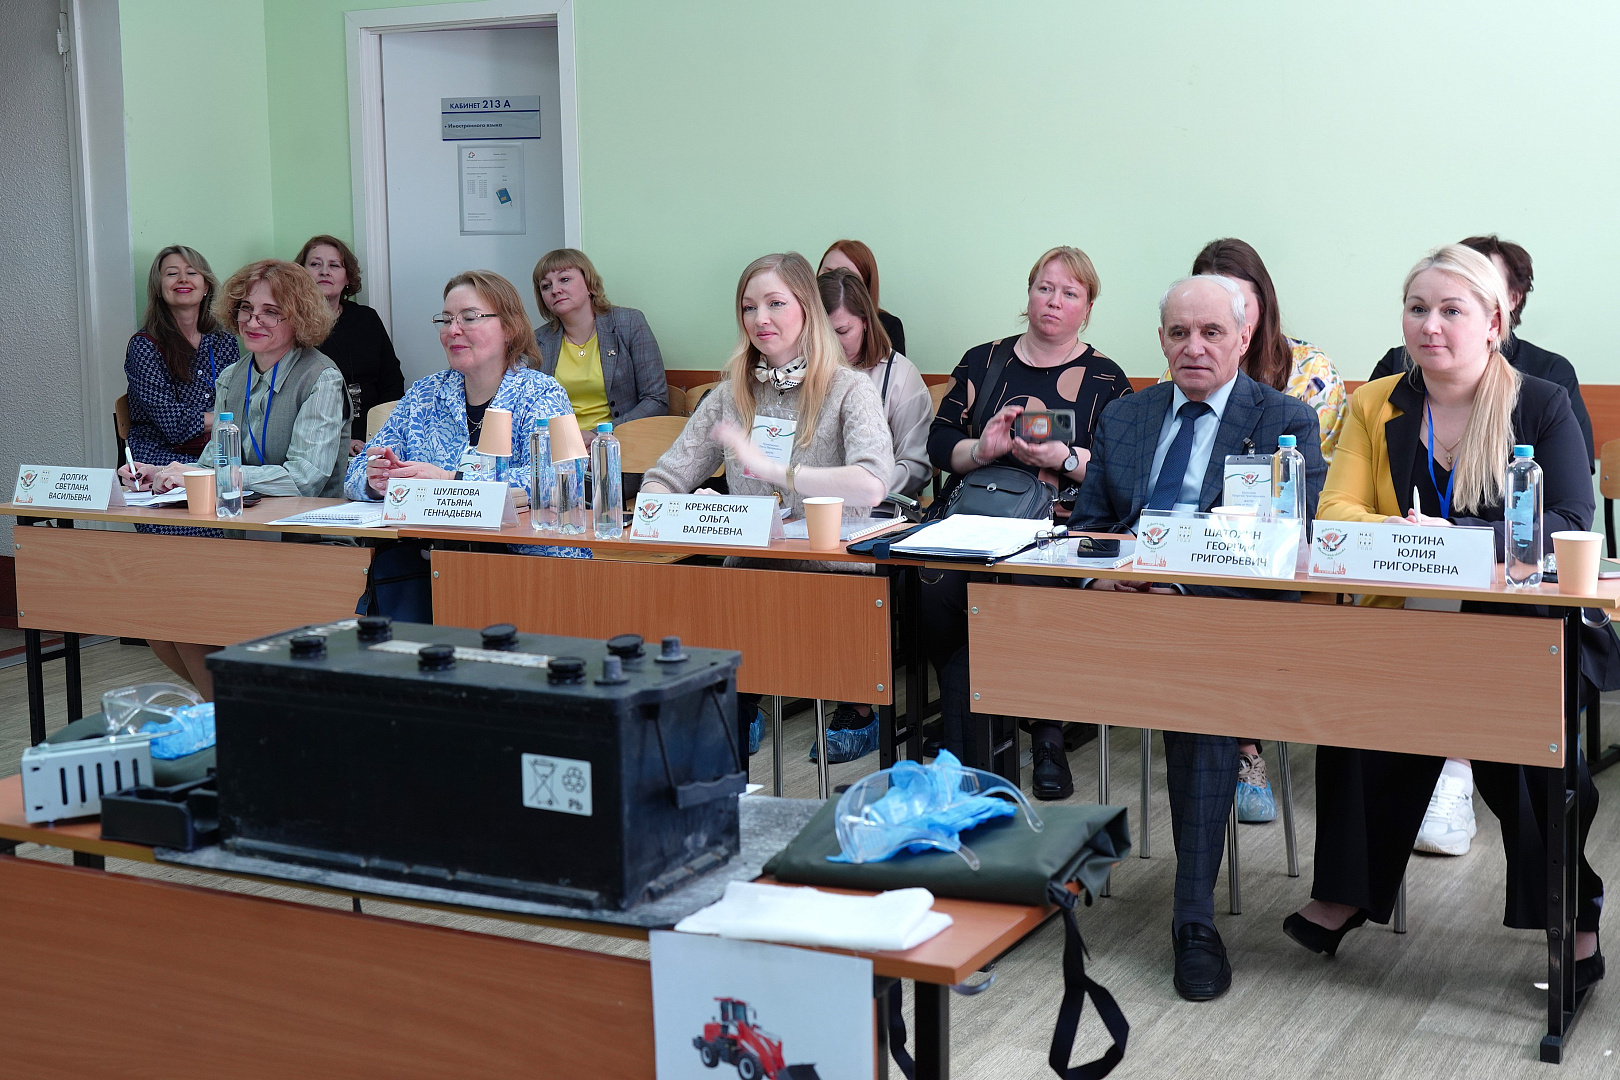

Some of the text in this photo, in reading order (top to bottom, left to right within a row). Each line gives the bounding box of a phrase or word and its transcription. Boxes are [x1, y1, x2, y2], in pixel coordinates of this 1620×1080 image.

[482, 100, 501, 108] 213
[60, 473, 88, 481] ДОЛГИХ
[55, 482, 89, 491] СВЕТЛАНА
[48, 492, 92, 501] ВАСИЛЬЕВНА
[434, 488, 480, 496] ШУЛЕПОВА
[436, 498, 473, 507] ТАТЬЯНА
[685, 502, 748, 513] КРЕЖЕВСКИХ
[424, 508, 482, 518] ГЕННАДЬЕВНА
[699, 514, 730, 524] ОЛЬГА
[682, 526, 742, 536] ВАЛЕРЬЕВНА
[1204, 528, 1262, 540] ШАТОН
[1392, 534, 1444, 546] ТЮТИНА
[1398, 548, 1436, 559] ЮЛИЯ
[1191, 553, 1267, 566] ГРИГОРЬЕВИЧ
[1373, 560, 1459, 575] ГРИГОРЬЕВНА
